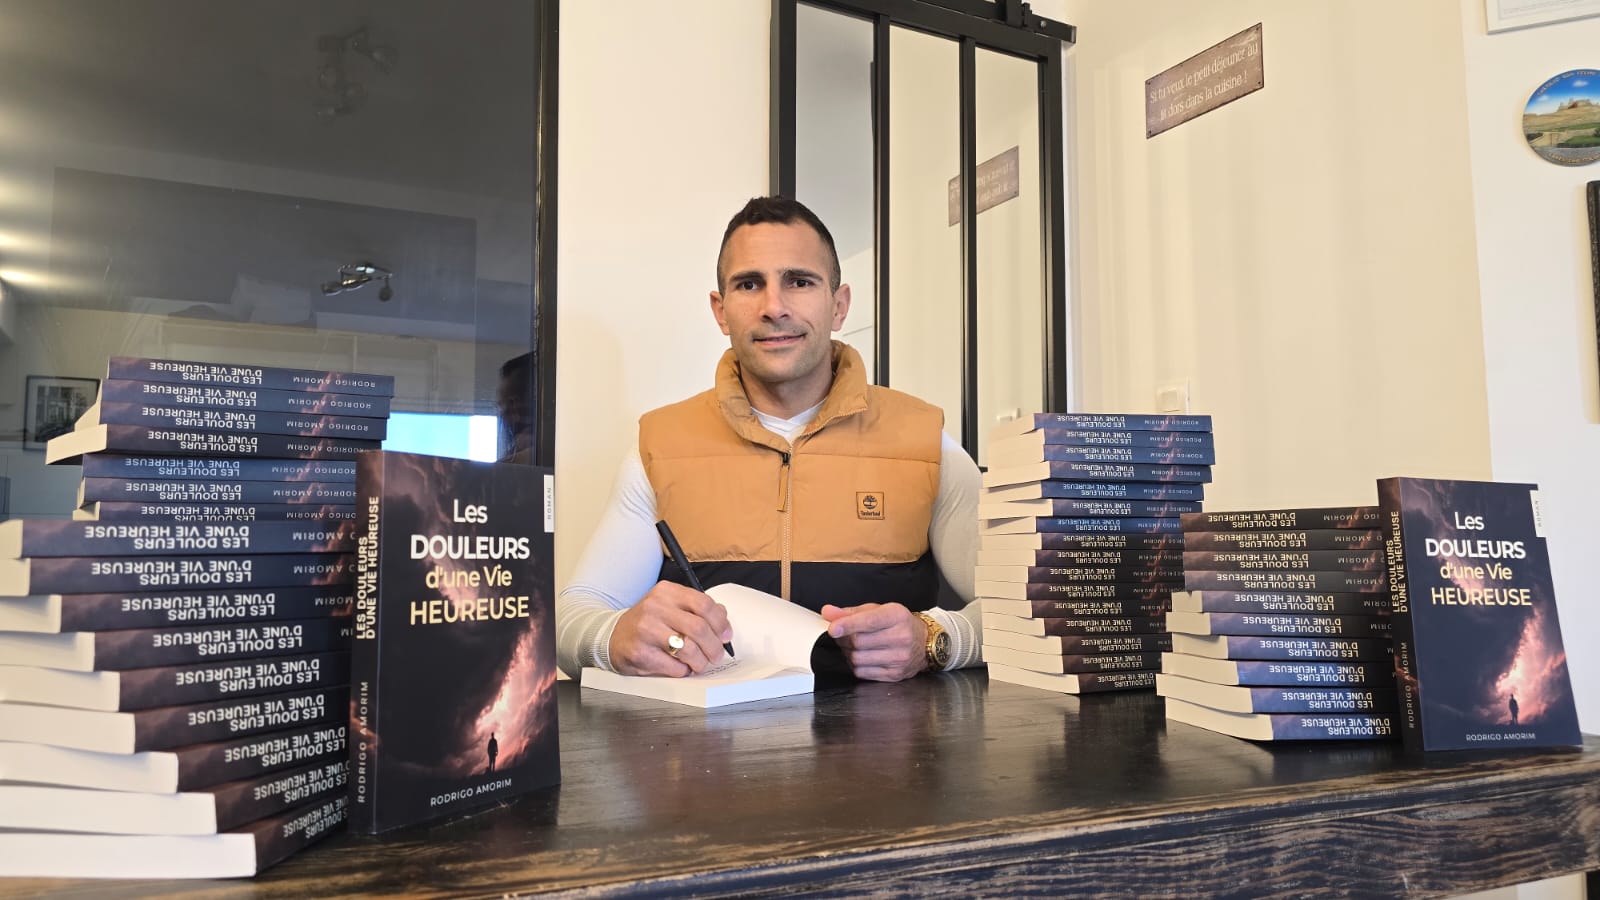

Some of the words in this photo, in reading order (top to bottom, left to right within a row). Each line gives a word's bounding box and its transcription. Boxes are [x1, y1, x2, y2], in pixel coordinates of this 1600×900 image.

[1186, 92, 1203, 108] dans
[1205, 87, 1212, 100] la
[1214, 73, 1241, 96] cuisine
[150, 362, 208, 373] HEUREUSE
[212, 367, 228, 375] VIE
[233, 368, 262, 377] D'UNE
[183, 373, 239, 383] DOULEURS
[244, 376, 261, 384] LES
[144, 385, 202, 395] HEUREUSE
[227, 390, 256, 398] D'UNE
[177, 396, 234, 405] DOULEURS
[142, 408, 201, 418] HEUREUSE
[205, 411, 221, 419] VIE
[226, 413, 255, 421] D'UNE
[176, 418, 233, 428] DOULEURS
[126, 459, 185, 467] HEUREUSE
[159, 468, 217, 476] DOULEURS
[126, 483, 186, 491] HEUREUSE
[454, 499, 488, 523] Les
[1257, 513, 1269, 521] VIE
[1208, 514, 1253, 522] HEUREUSE
[1454, 512, 1484, 530] Les
[85, 526, 170, 537] HEUREUSE
[176, 526, 199, 537] VIE
[206, 526, 249, 536] D'UNE
[368, 497, 379, 567] HEUREUSE
[1391, 512, 1402, 561] HEUREUSE
[135, 538, 217, 549] DOULEURS
[224, 538, 249, 548] LES
[411, 534, 530, 559] DOULEURS
[1425, 538, 1526, 559] DOULEURS
[92, 562, 175, 574] HEUREUSE
[180, 561, 203, 572] VIE
[209, 560, 251, 572] D'UNE
[1387, 540, 1398, 591] DOULEURS
[1397, 564, 1405, 579] VIE
[1440, 563, 1484, 579] d'une
[1486, 563, 1512, 579] Vie
[140, 572, 220, 585] DOULEURS
[227, 571, 251, 583] LES
[357, 537, 368, 609] DOULEURS
[426, 566, 480, 589] d'une
[484, 565, 512, 586] Vie
[368, 571, 377, 593] VIE
[1244, 581, 1295, 589] DOULEURS
[1300, 581, 1315, 589] LES
[207, 595, 229, 607] VIE
[235, 593, 275, 606] D'UNE
[1398, 583, 1407, 613] D'UNE
[1431, 587, 1533, 606] HEUREUSE
[121, 596, 201, 611] HEUREUSE
[252, 604, 275, 616] LES
[1392, 594, 1400, 613] LES
[168, 606, 245, 621] DOULEURS
[410, 596, 529, 625] HEUREUSE
[366, 598, 376, 639] D'UNE
[1243, 617, 1294, 625] HEUREUSE
[263, 625, 302, 639] D'UNE
[357, 614, 366, 639] LES
[1272, 625, 1322, 633] DOULEURS
[153, 630, 230, 647] HEUREUSE
[236, 628, 257, 641] VIE
[199, 639, 273, 655] DOULEURS
[280, 637, 302, 648] LES
[282, 660, 319, 674] D'UNE
[1401, 642, 1409, 680] AMORIM
[176, 666, 251, 685] HEUREUSE
[256, 663, 276, 676] VIE
[1322, 666, 1335, 674] VIE
[220, 674, 292, 692] DOULEURS
[298, 670, 319, 683] LES
[1297, 673, 1346, 682] DOULEURS
[1350, 674, 1364, 682] LES
[264, 700, 283, 714] VIE
[288, 695, 324, 710] D'UNE
[359, 681, 368, 735] AMORIM
[188, 703, 259, 725] HEUREUSE
[304, 706, 324, 720] LES
[230, 710, 298, 731] DOULEURS
[1302, 718, 1347, 727] HEUREUSE
[314, 727, 345, 744] D'UNE
[1328, 727, 1373, 735] DOULEURS
[292, 734, 309, 748] VIE
[327, 739, 345, 753] LES
[225, 738, 287, 762] HEUREUSE
[262, 743, 322, 767] DOULEURS
[358, 742, 367, 803] RODRIGO
[430, 787, 473, 807] RODRIGO
[476, 778, 512, 795] AMORIM
